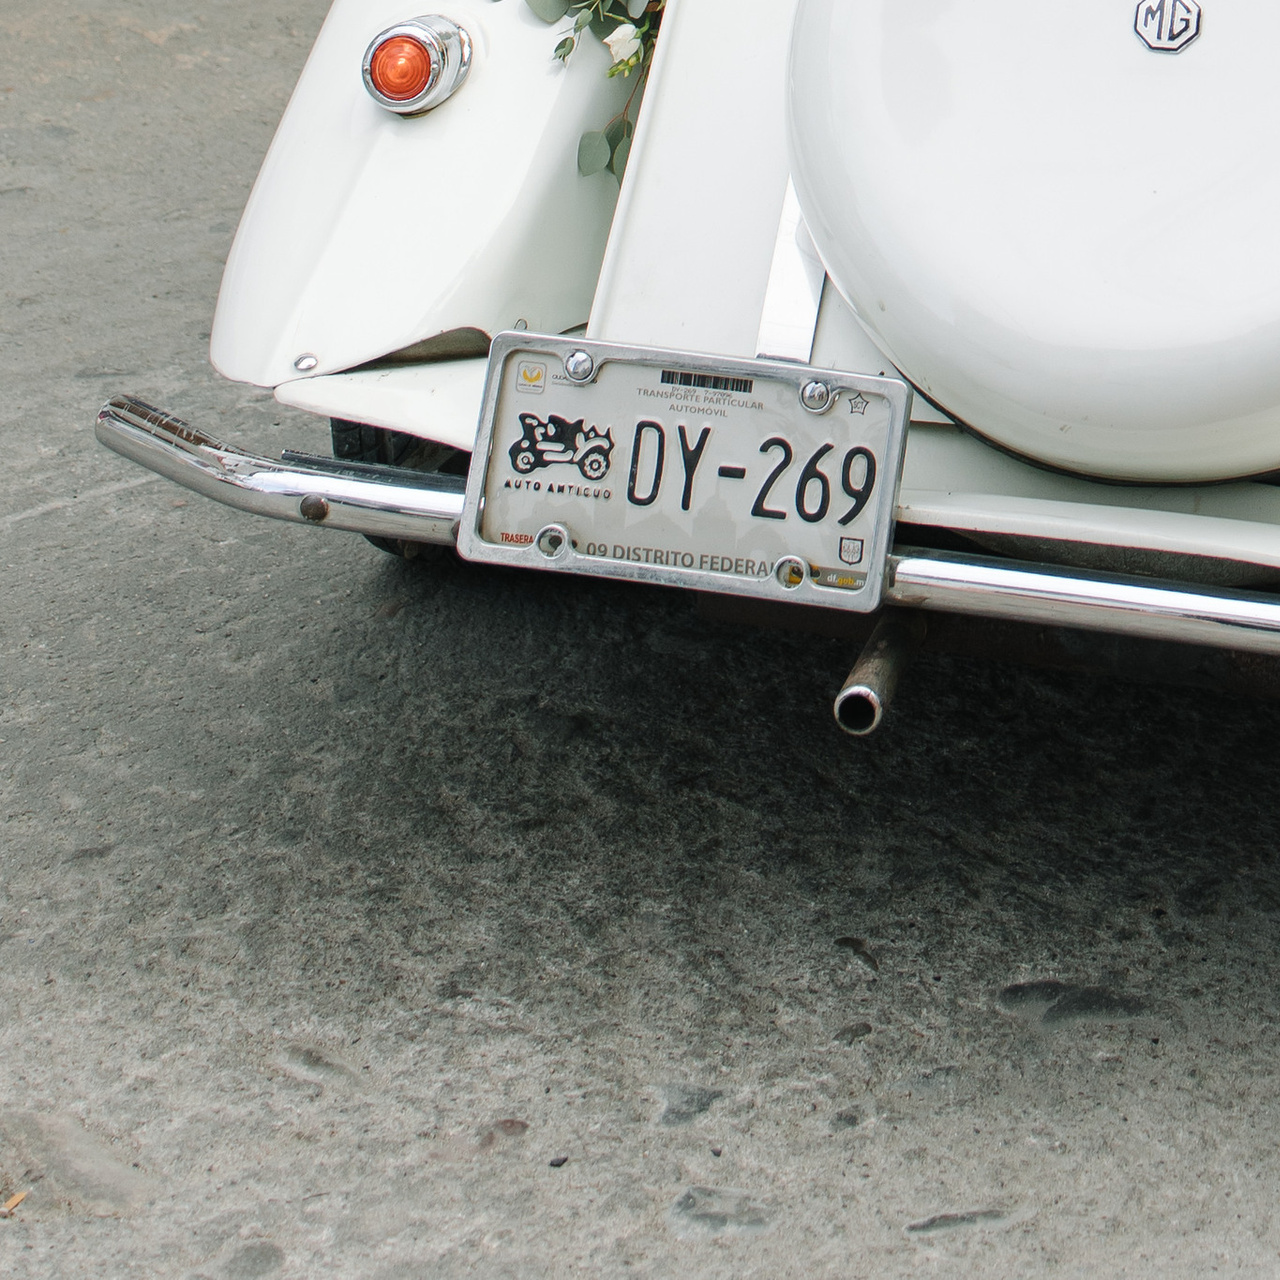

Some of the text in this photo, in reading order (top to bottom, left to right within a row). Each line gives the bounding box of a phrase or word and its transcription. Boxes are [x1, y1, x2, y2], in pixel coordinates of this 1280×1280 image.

[637, 388, 764, 410] TRANSPORTE PARTICULAR
[669, 403, 728, 417] AUTOMÓVIL
[626, 420, 876, 526] DY-269
[504, 479, 541, 492] AUTO
[501, 532, 534, 543] TRASERA
[586, 542, 608, 557] 09
[613, 544, 695, 568] DISTRITO
[827, 573, 864, 587] df.gob.m
